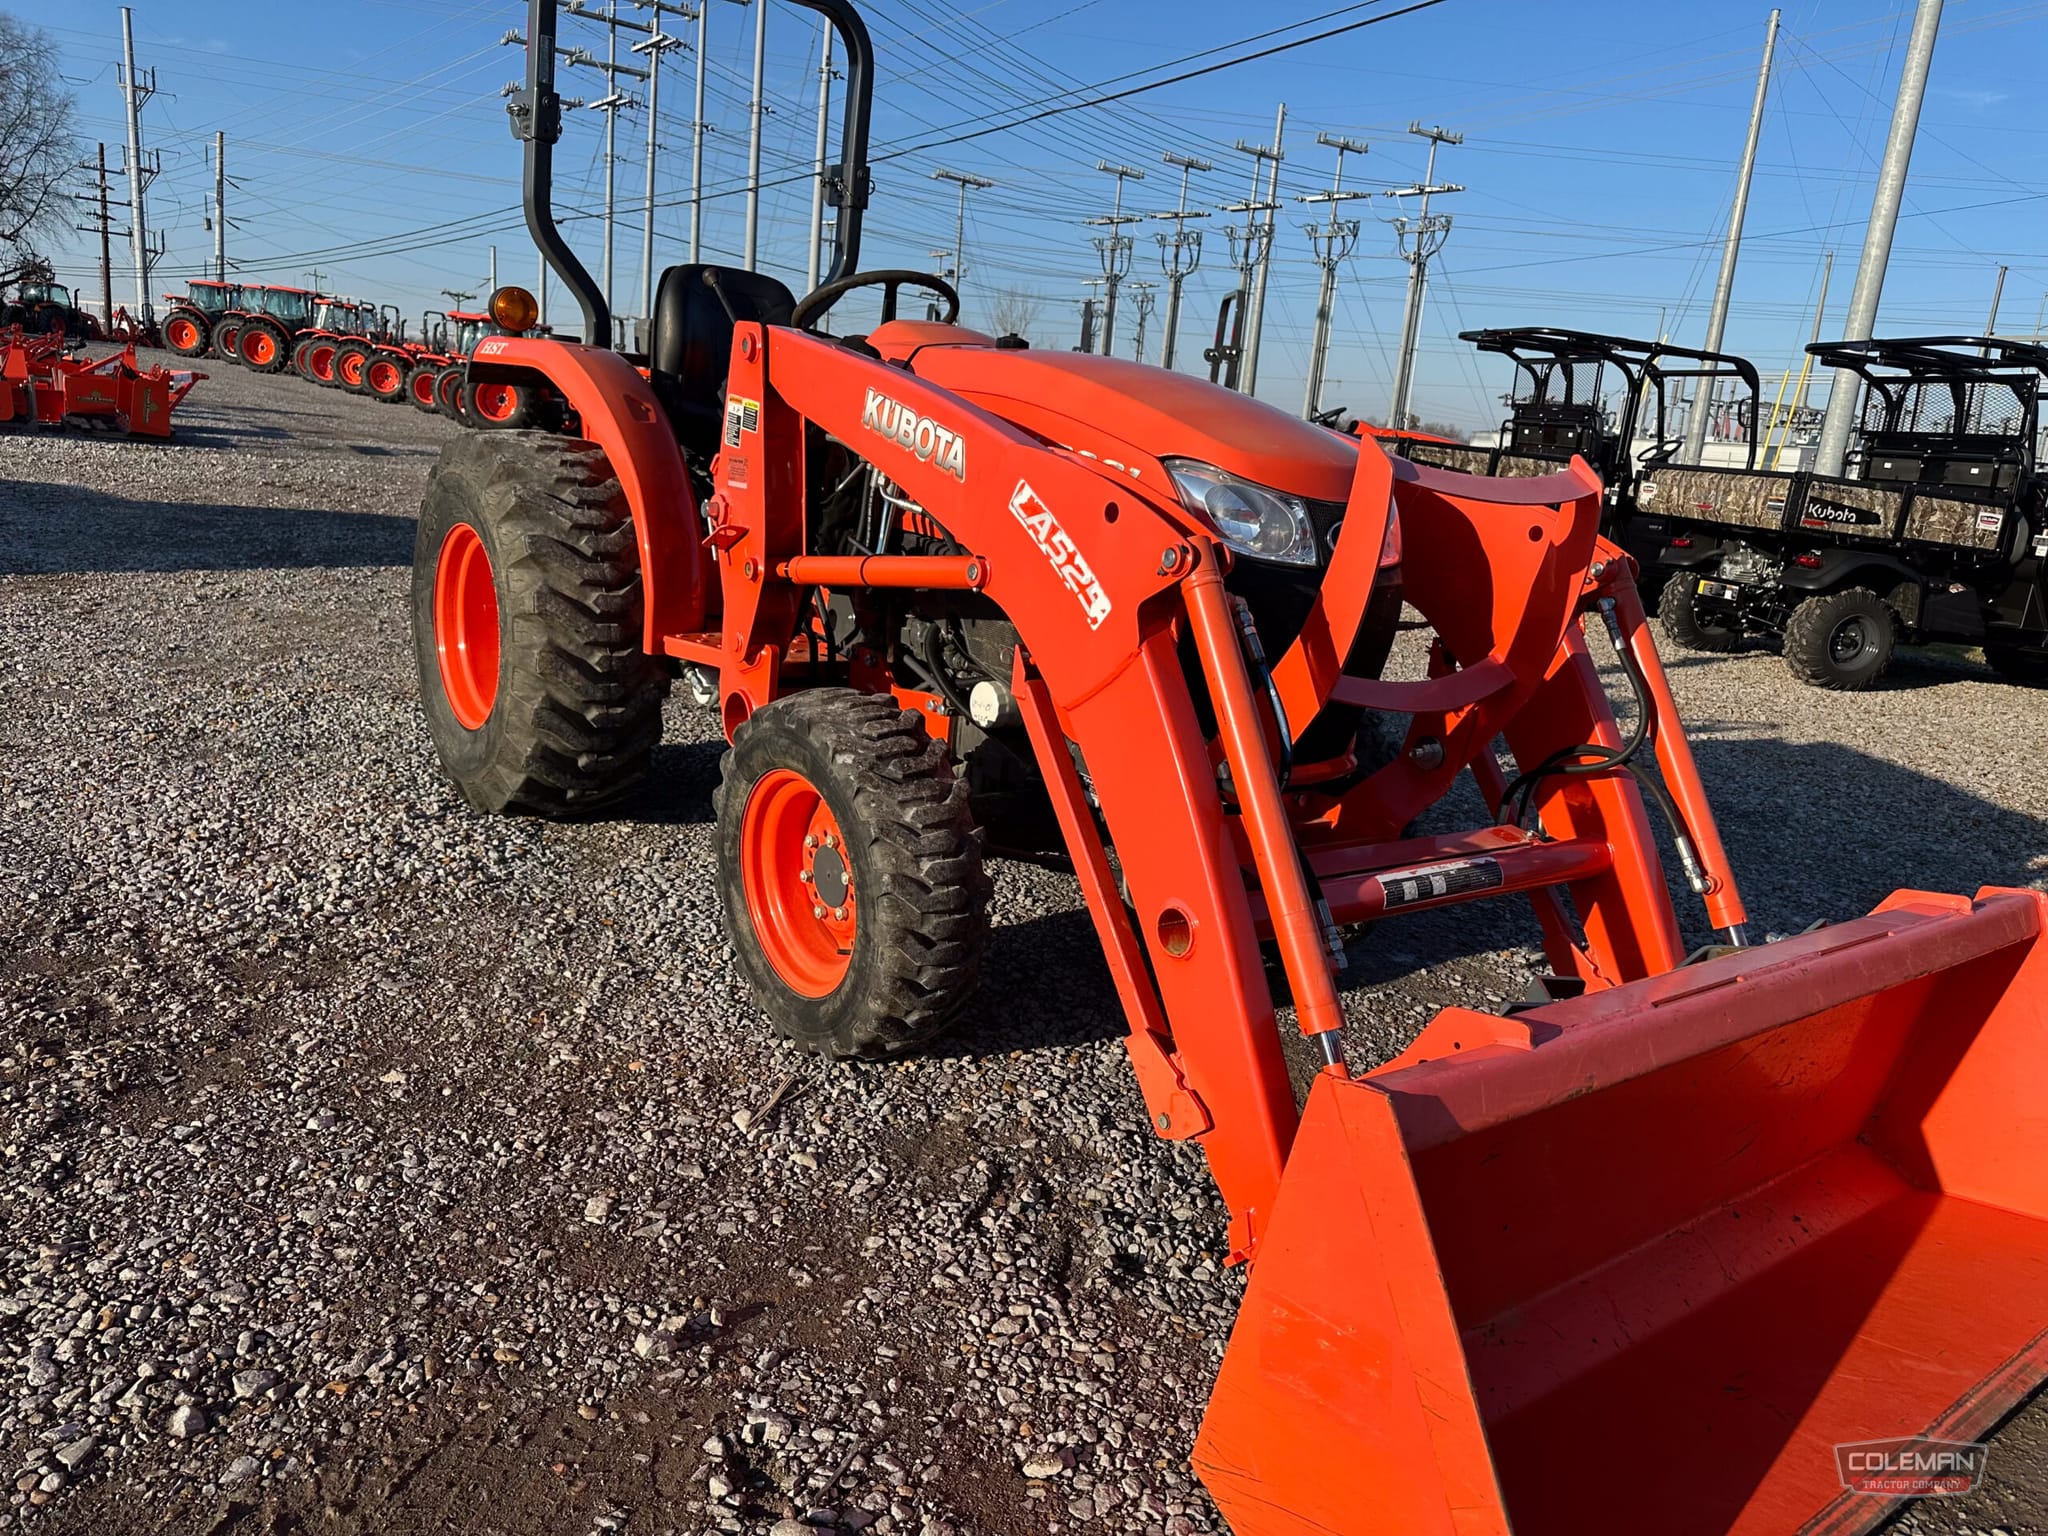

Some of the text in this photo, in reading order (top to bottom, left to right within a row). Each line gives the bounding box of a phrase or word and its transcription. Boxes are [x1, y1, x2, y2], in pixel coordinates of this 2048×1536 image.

[481, 341, 509, 355] HST
[862, 387, 965, 482] KUBOTA
[1808, 503, 1857, 523] Kubota
